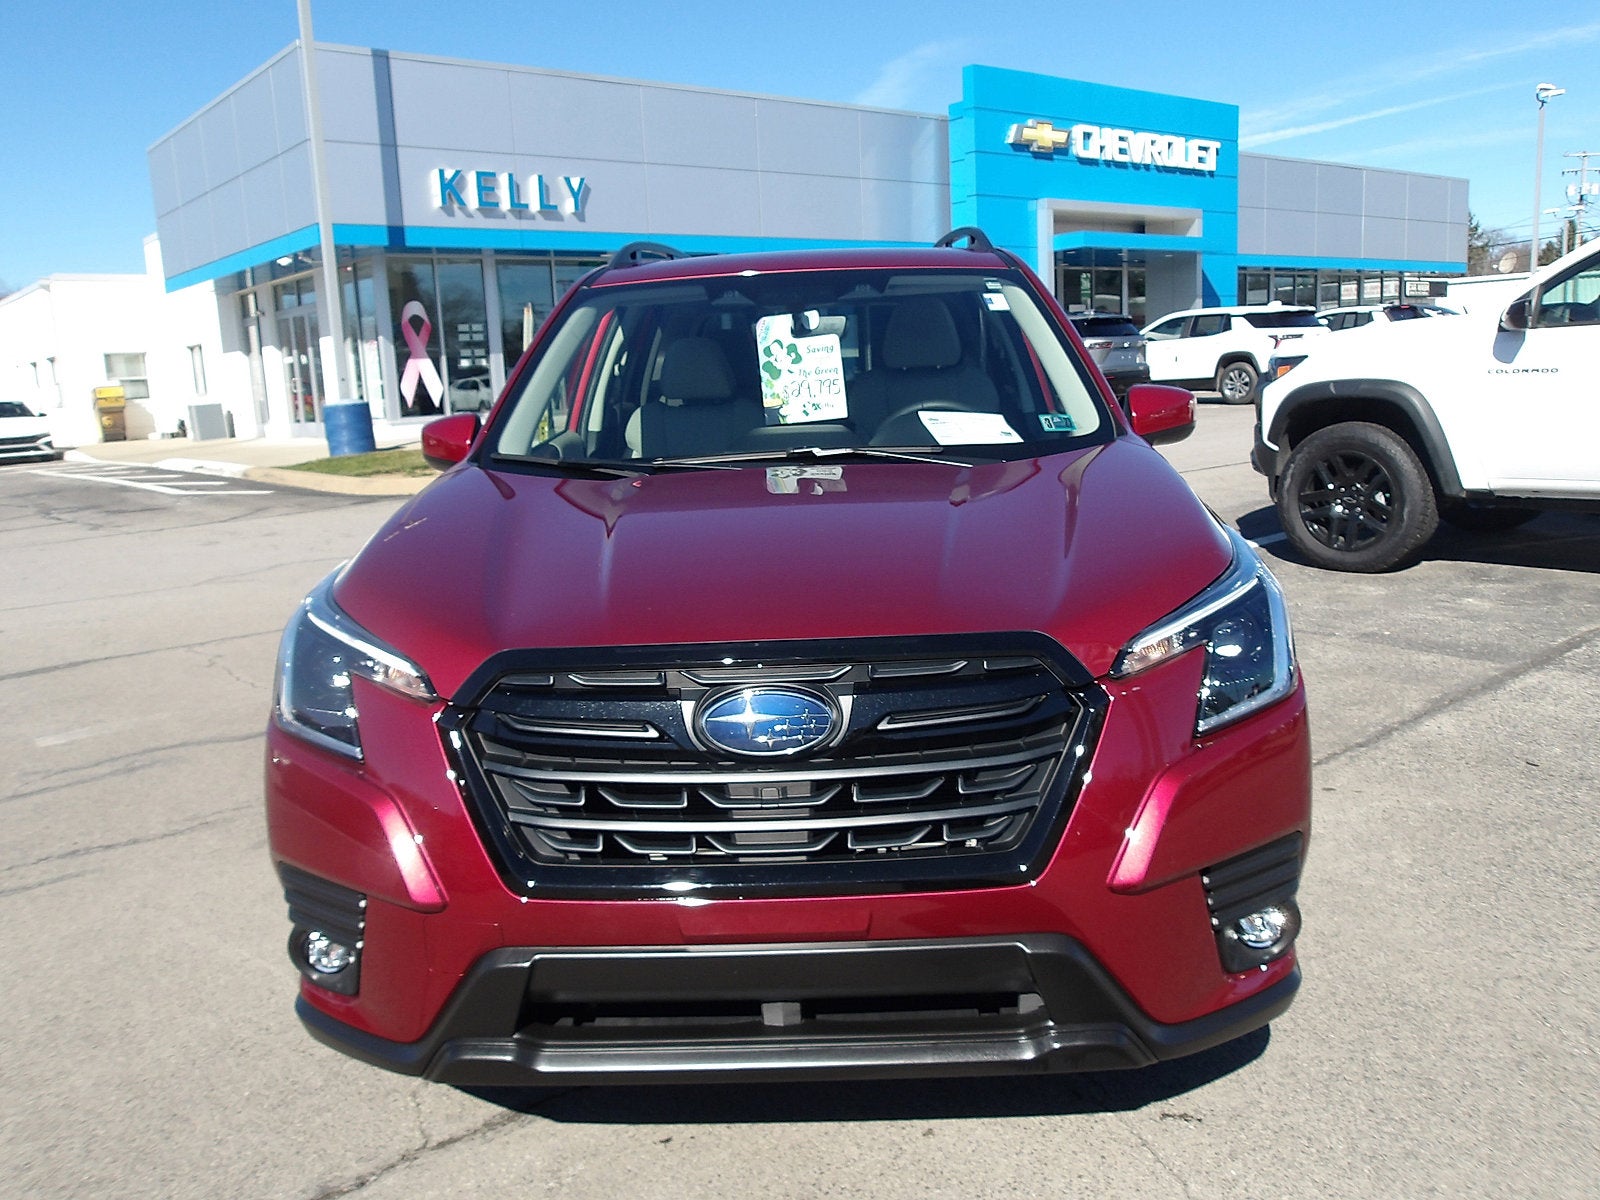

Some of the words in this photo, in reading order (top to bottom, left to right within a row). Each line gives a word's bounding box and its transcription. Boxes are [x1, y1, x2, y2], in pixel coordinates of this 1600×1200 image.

[1071, 123, 1221, 172] CHEVROLET
[430, 167, 586, 214] KELLY
[814, 366, 839, 376] Green
[1487, 367, 1559, 375] COLORADO
